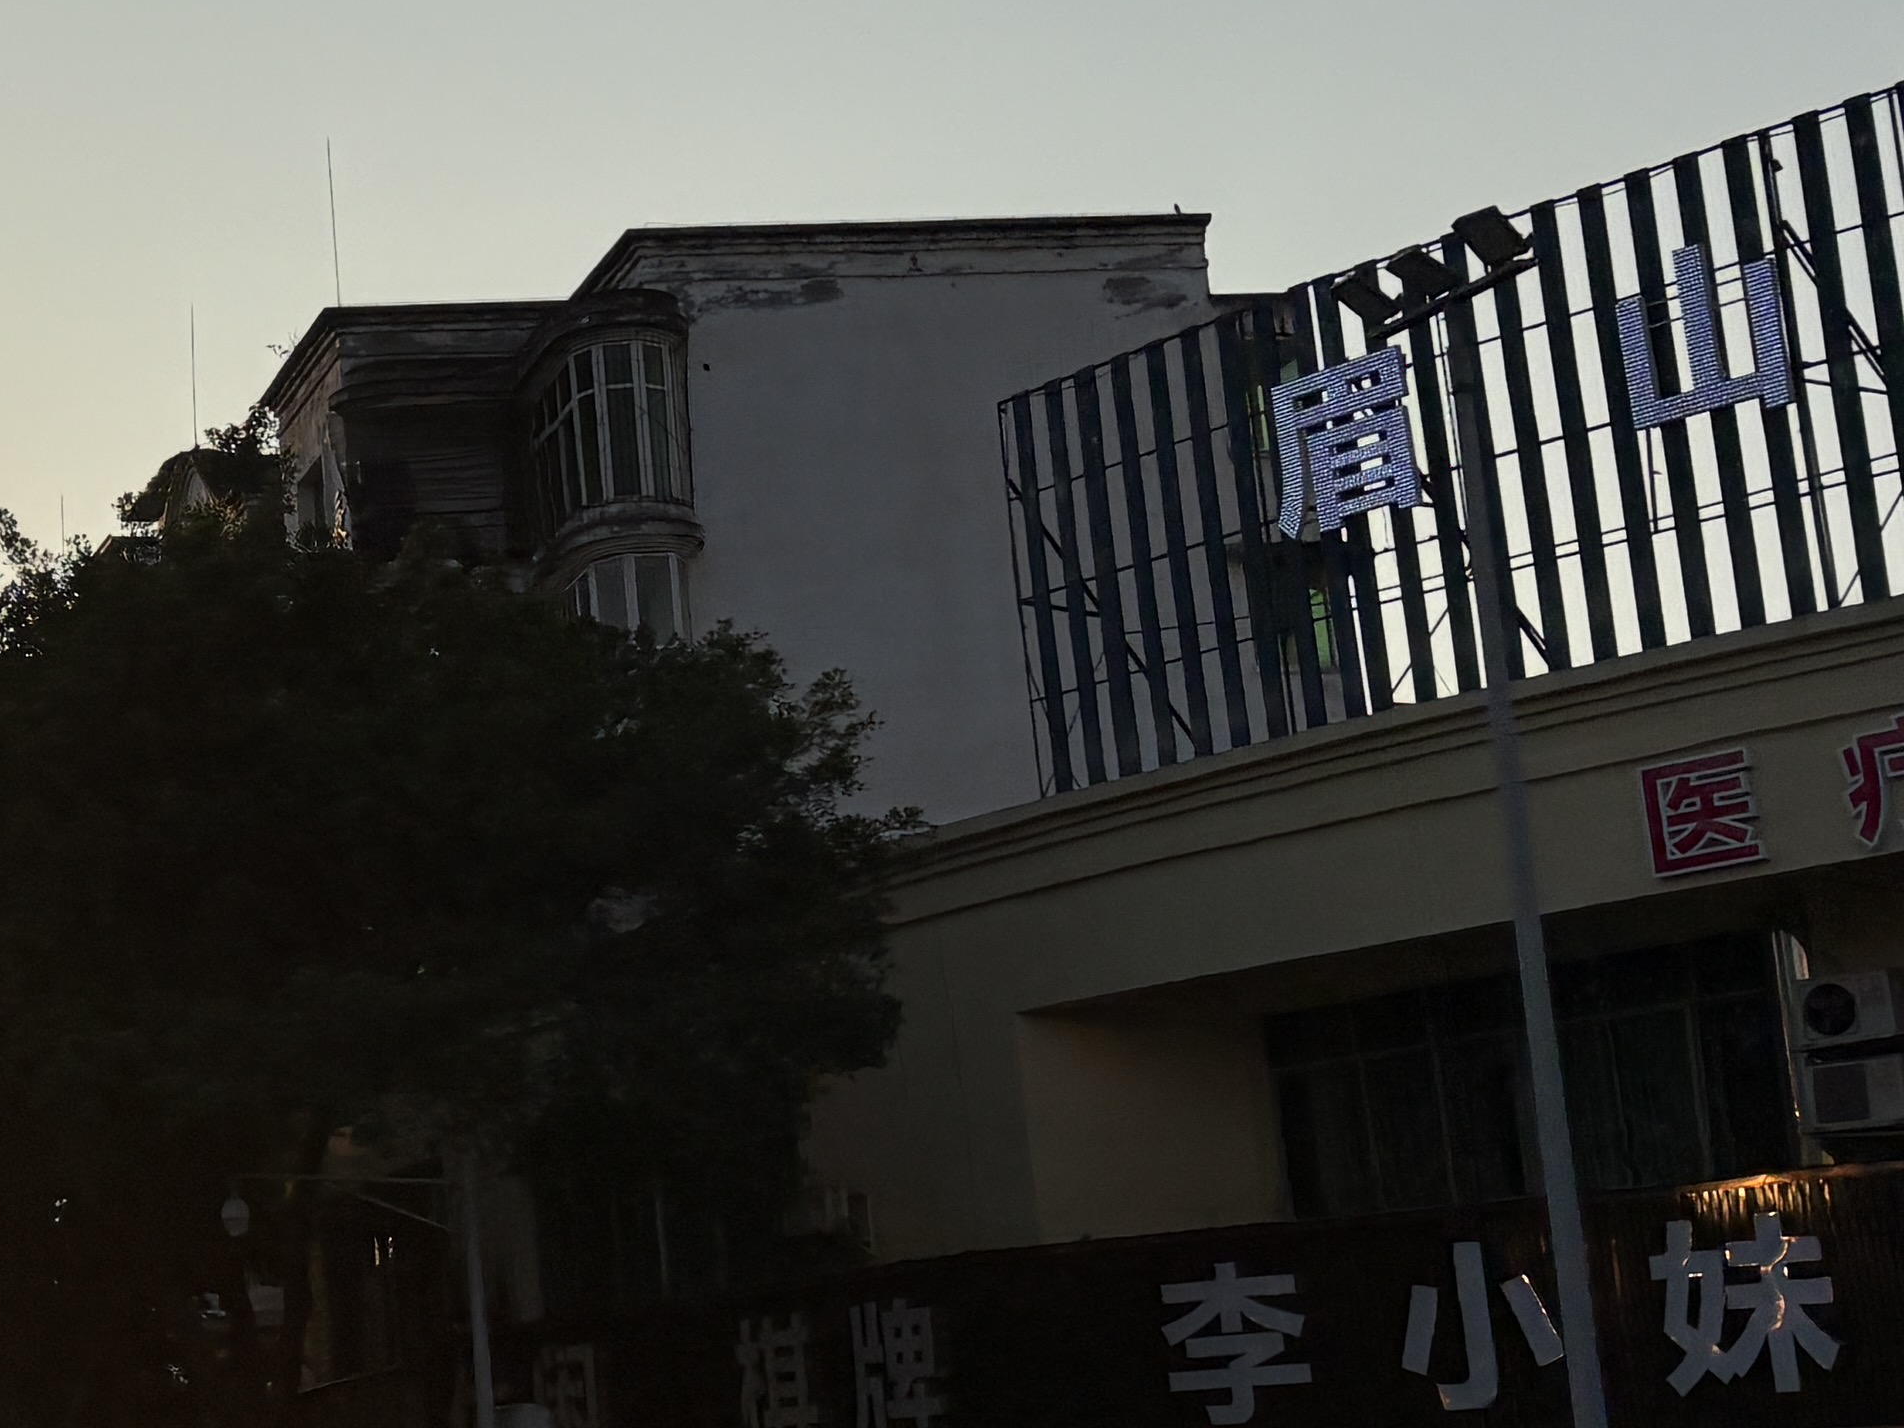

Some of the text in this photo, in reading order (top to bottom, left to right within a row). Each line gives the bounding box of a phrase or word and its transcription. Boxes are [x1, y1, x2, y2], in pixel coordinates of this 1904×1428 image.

[1270, 244, 1797, 540] 眉山
[1159, 1211, 1841, 1427] 李小妹
